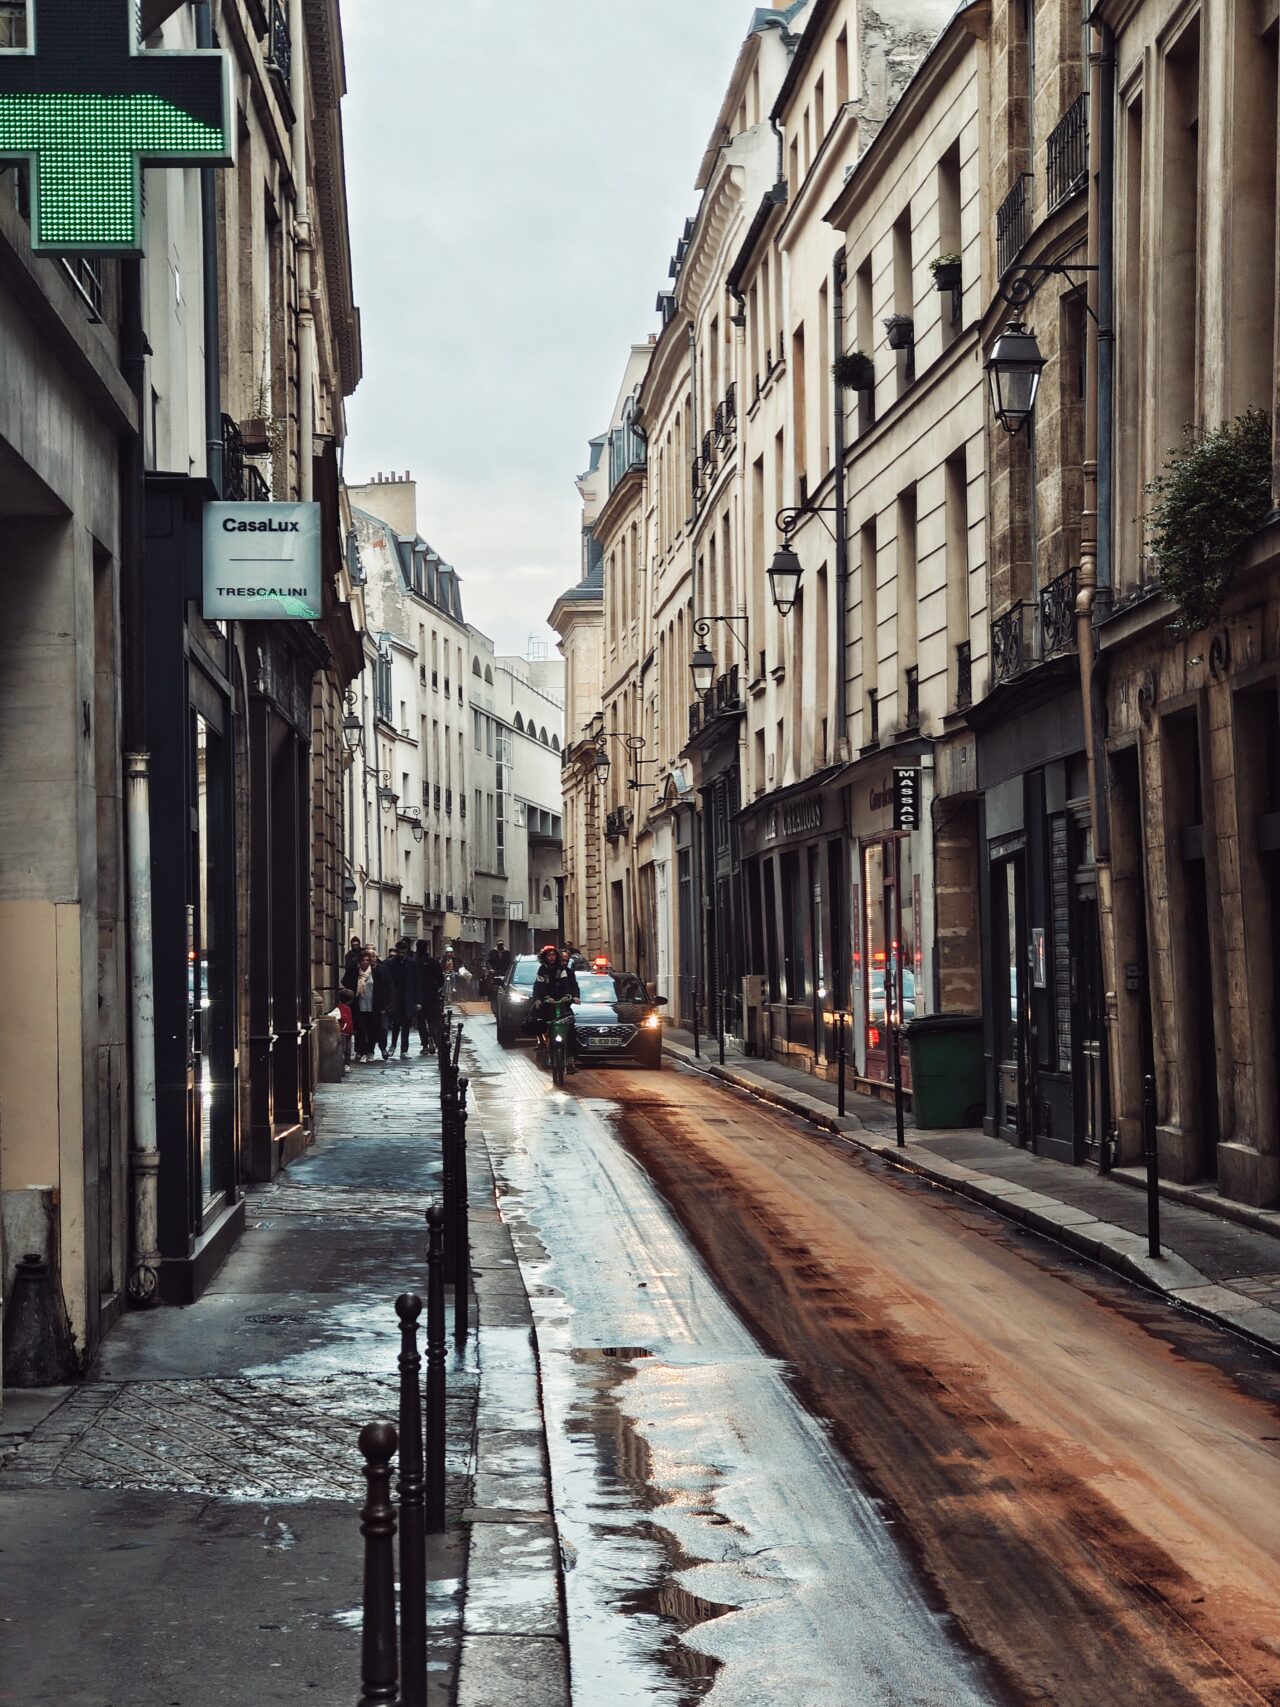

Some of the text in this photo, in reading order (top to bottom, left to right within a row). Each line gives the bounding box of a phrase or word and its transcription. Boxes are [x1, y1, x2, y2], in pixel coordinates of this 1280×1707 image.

[222, 518, 299, 532] CasaLux
[216, 587, 307, 597] TRESCALINI
[898, 770, 914, 830] MASSAGE
